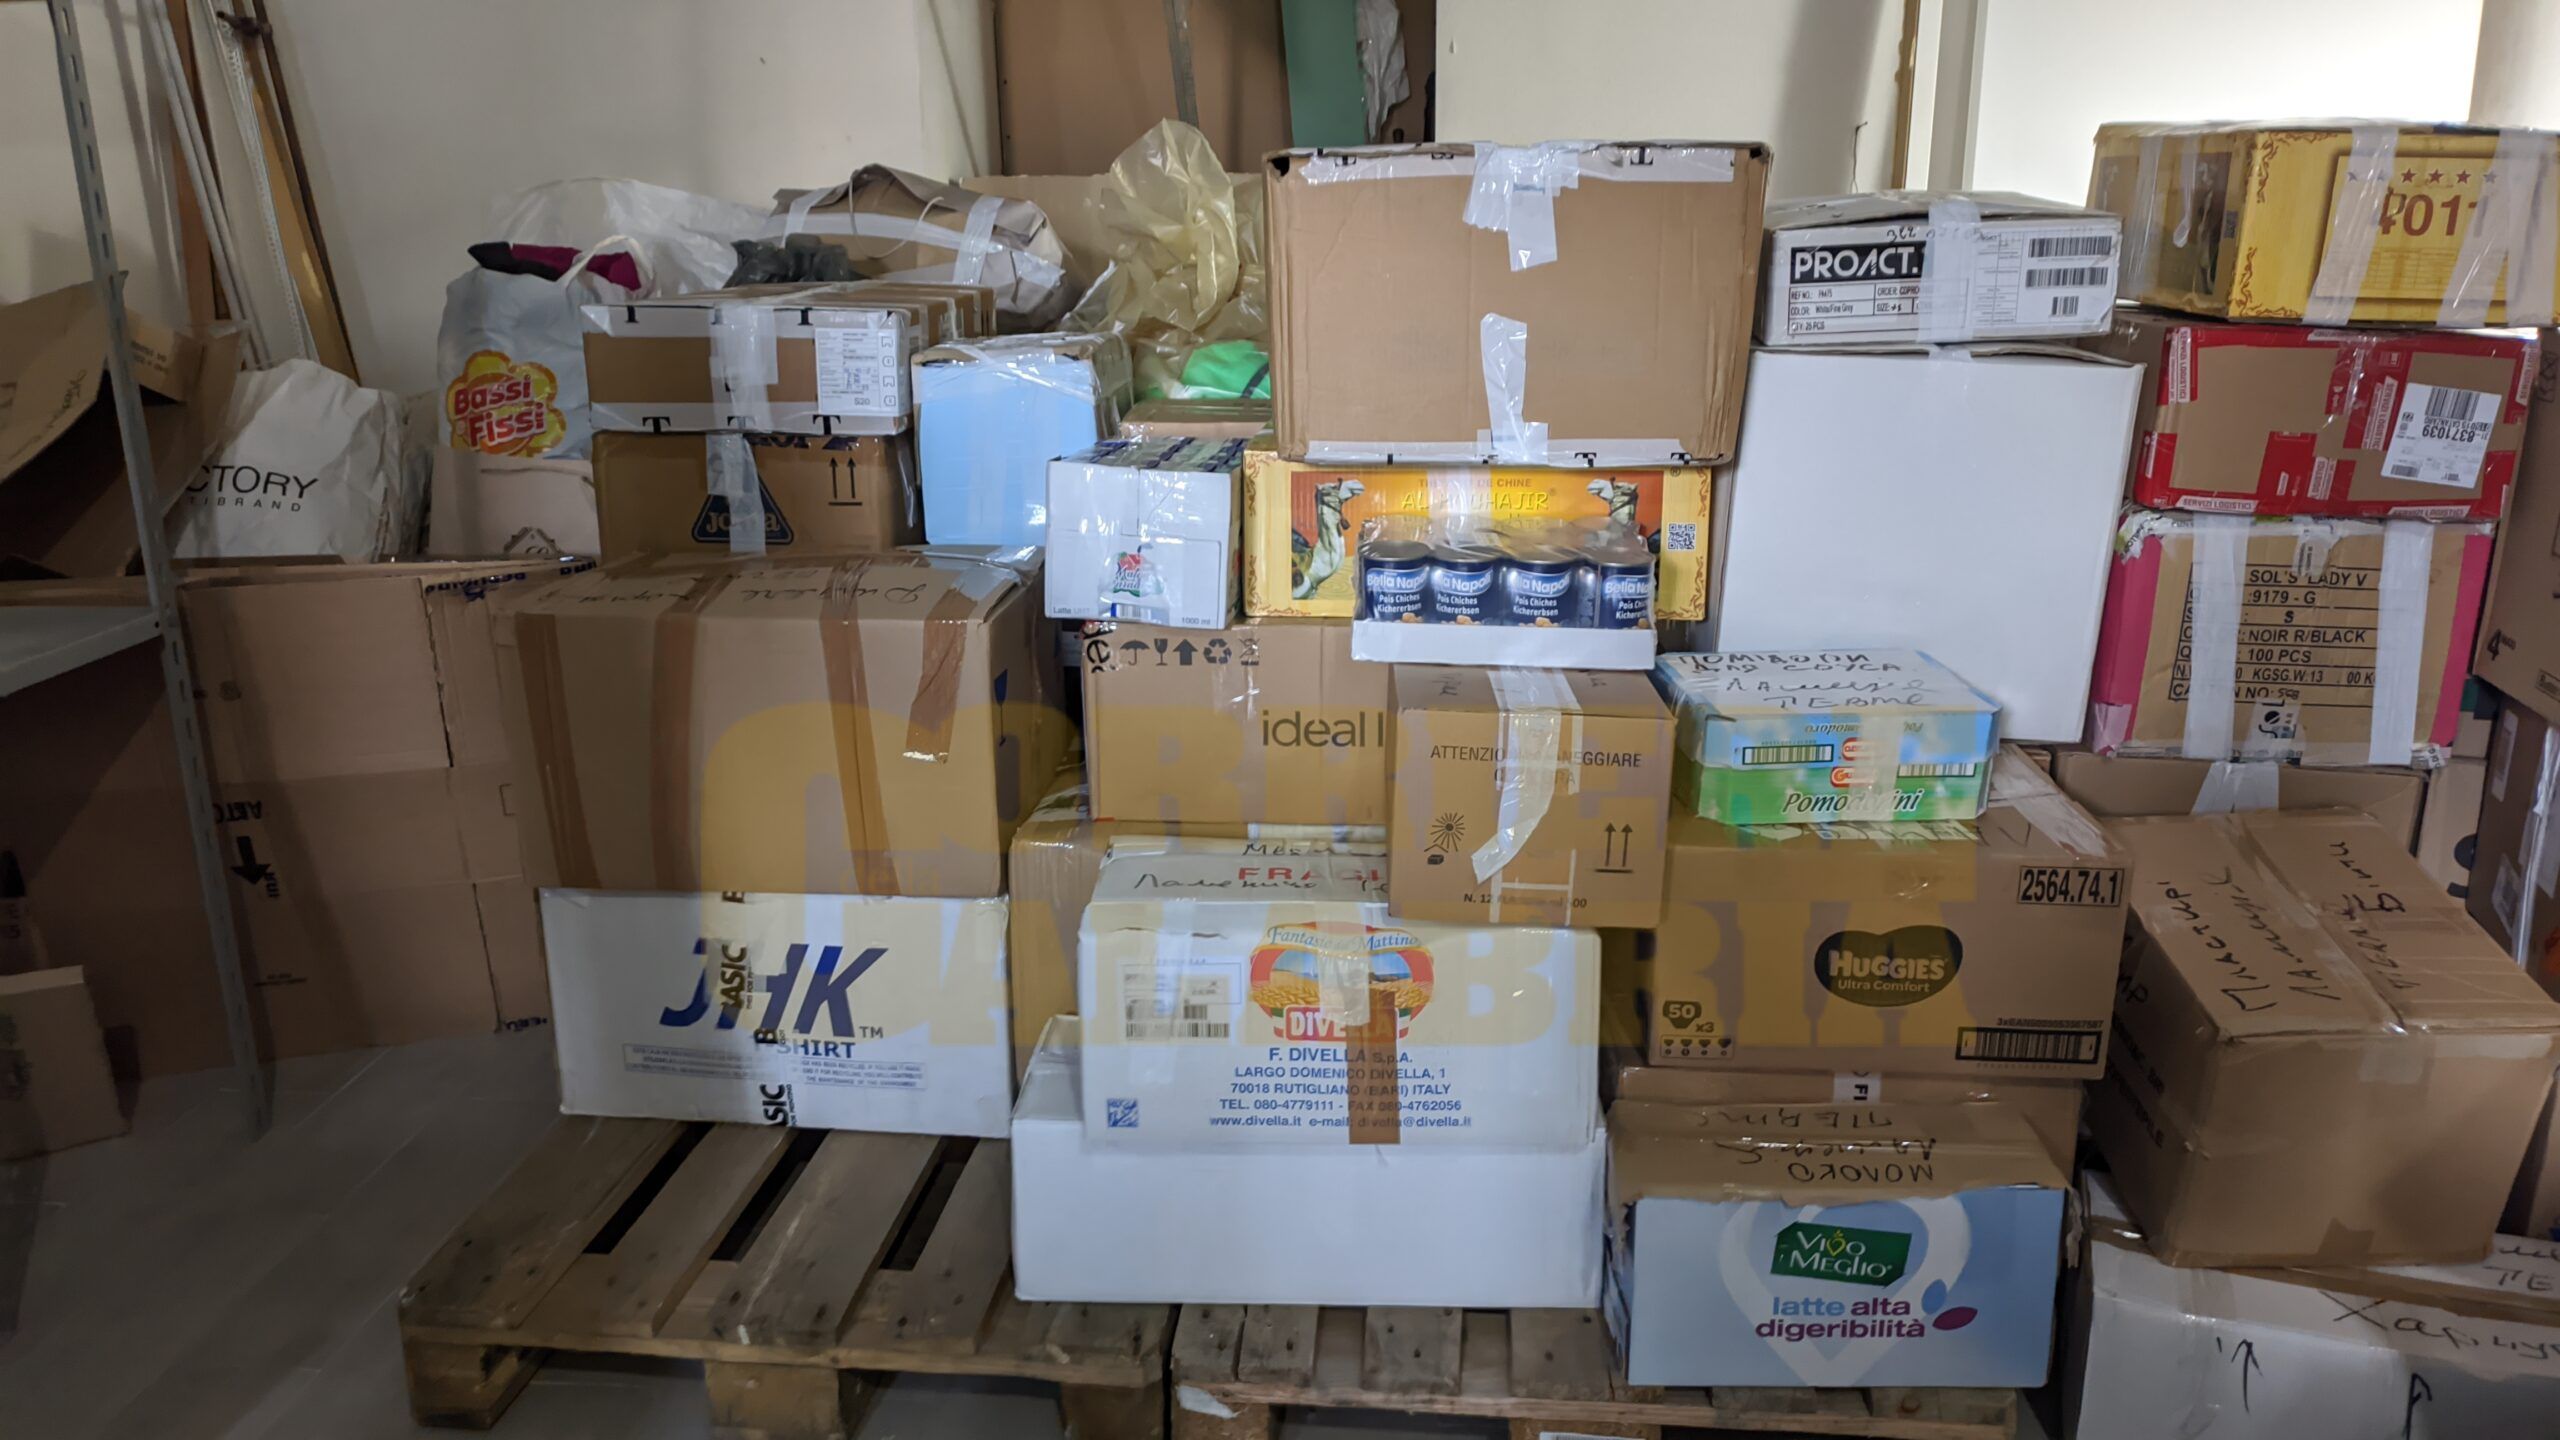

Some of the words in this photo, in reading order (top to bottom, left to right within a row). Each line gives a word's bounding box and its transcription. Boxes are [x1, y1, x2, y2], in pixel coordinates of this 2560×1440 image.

[454, 375, 532, 416] Bassi
[468, 402, 545, 447] Fissi
[2247, 629, 2288, 643] NOIR
[2293, 629, 2367, 644] R/BLACK
[2248, 648, 2275, 662] 100
[2278, 648, 2312, 663] PCS
[2021, 869, 2120, 905] 2564.74.1
[1828, 950, 1945, 981] HUGGIES
[1837, 979, 1871, 991] Ultra
[1873, 980, 1931, 993] Comfort
[1667, 1003, 1697, 1020] 50
[1694, 1021, 1715, 1034] x3
[1269, 1048, 1283, 1062] F.
[1289, 1048, 1366, 1063] DIVELLA
[1235, 1067, 1286, 1079] LARGO
[1290, 1067, 1366, 1080] DOMENICO
[1440, 1068, 1446, 1079] 1
[1231, 1083, 1271, 1095] 70018
[1274, 1083, 1361, 1097] RUTIGLIANO
[1411, 1083, 1451, 1096] ITALY
[1219, 1098, 1250, 1111] TEL.
[1253, 1098, 1335, 1112] 080-4779111
[1349, 1100, 1374, 1112] FAX
[1209, 1116, 1302, 1128] www.divella.it
[1772, 1296, 1846, 1317] latte
[1850, 1297, 1912, 1317] alta
[1755, 1318, 1927, 1343] digeribilità
